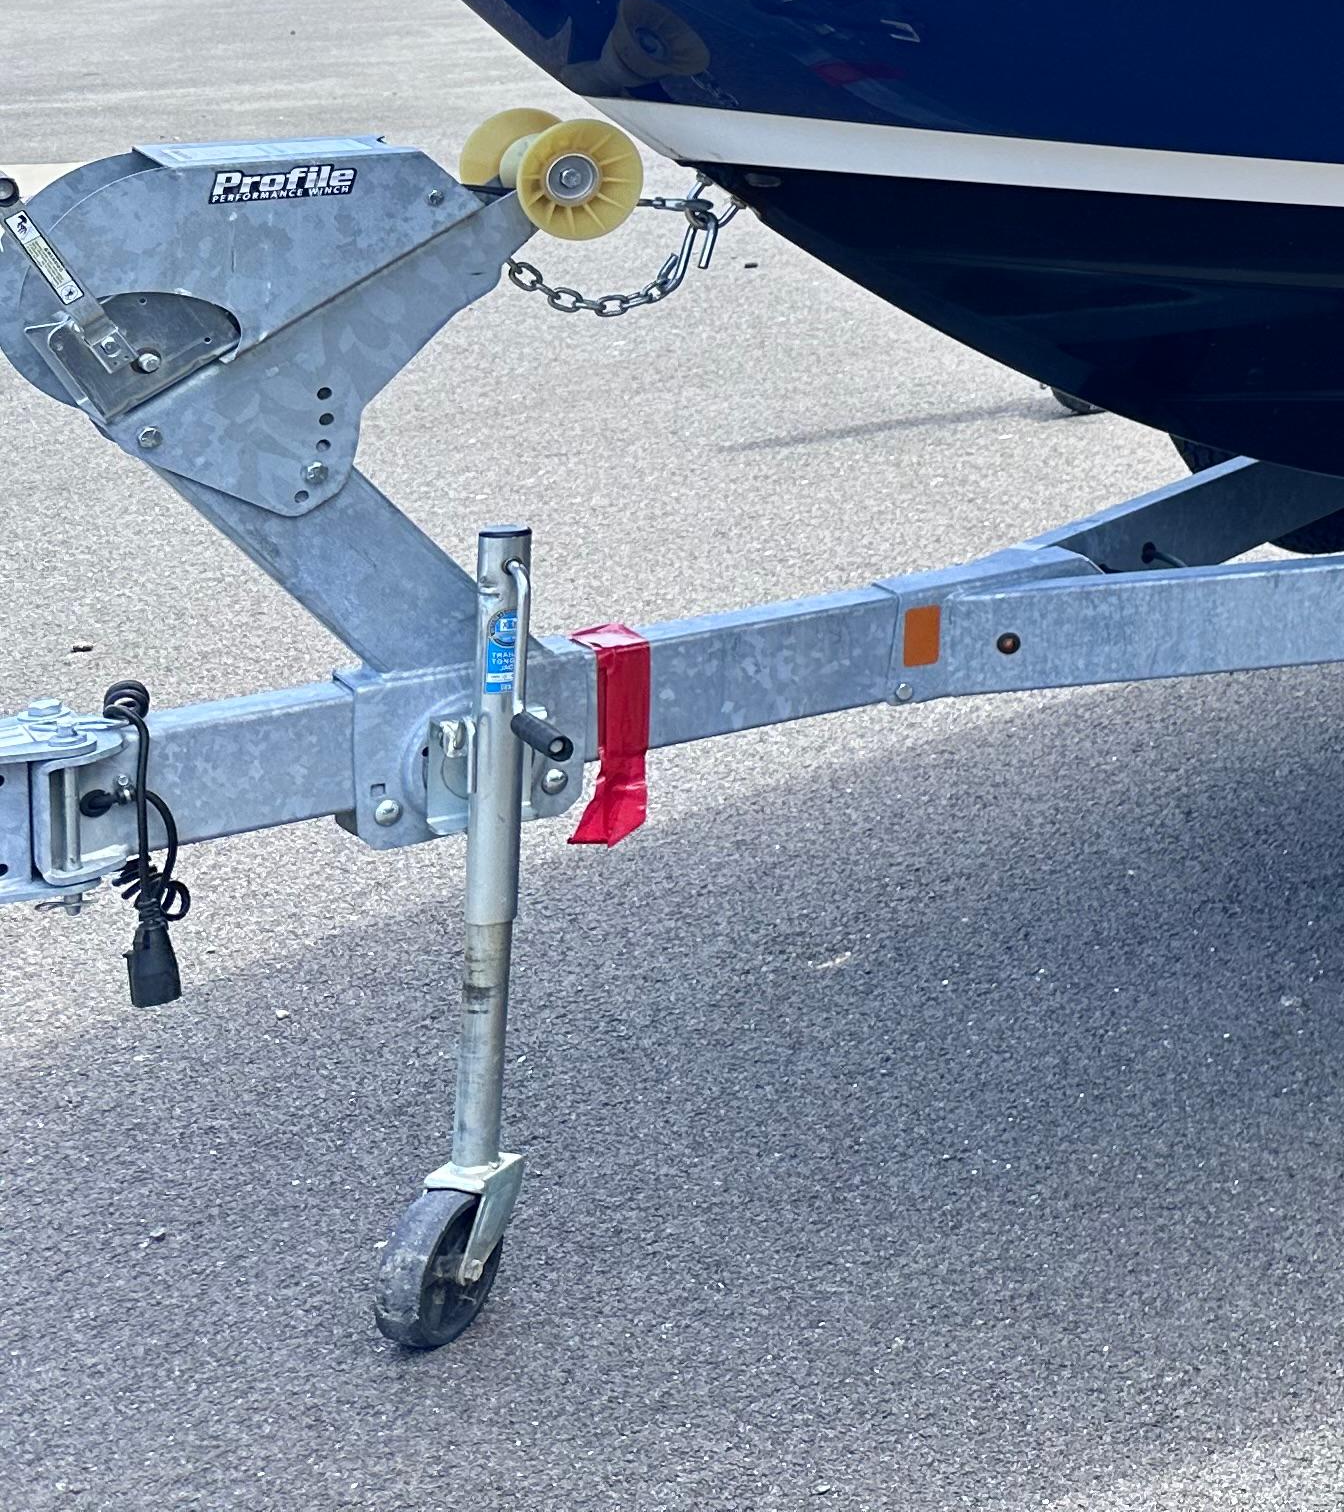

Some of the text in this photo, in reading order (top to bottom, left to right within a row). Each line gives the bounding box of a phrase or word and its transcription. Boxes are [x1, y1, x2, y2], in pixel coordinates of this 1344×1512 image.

[212, 165, 355, 195] Profile
[211, 185, 349, 203] PERFORMANCE WINCH
